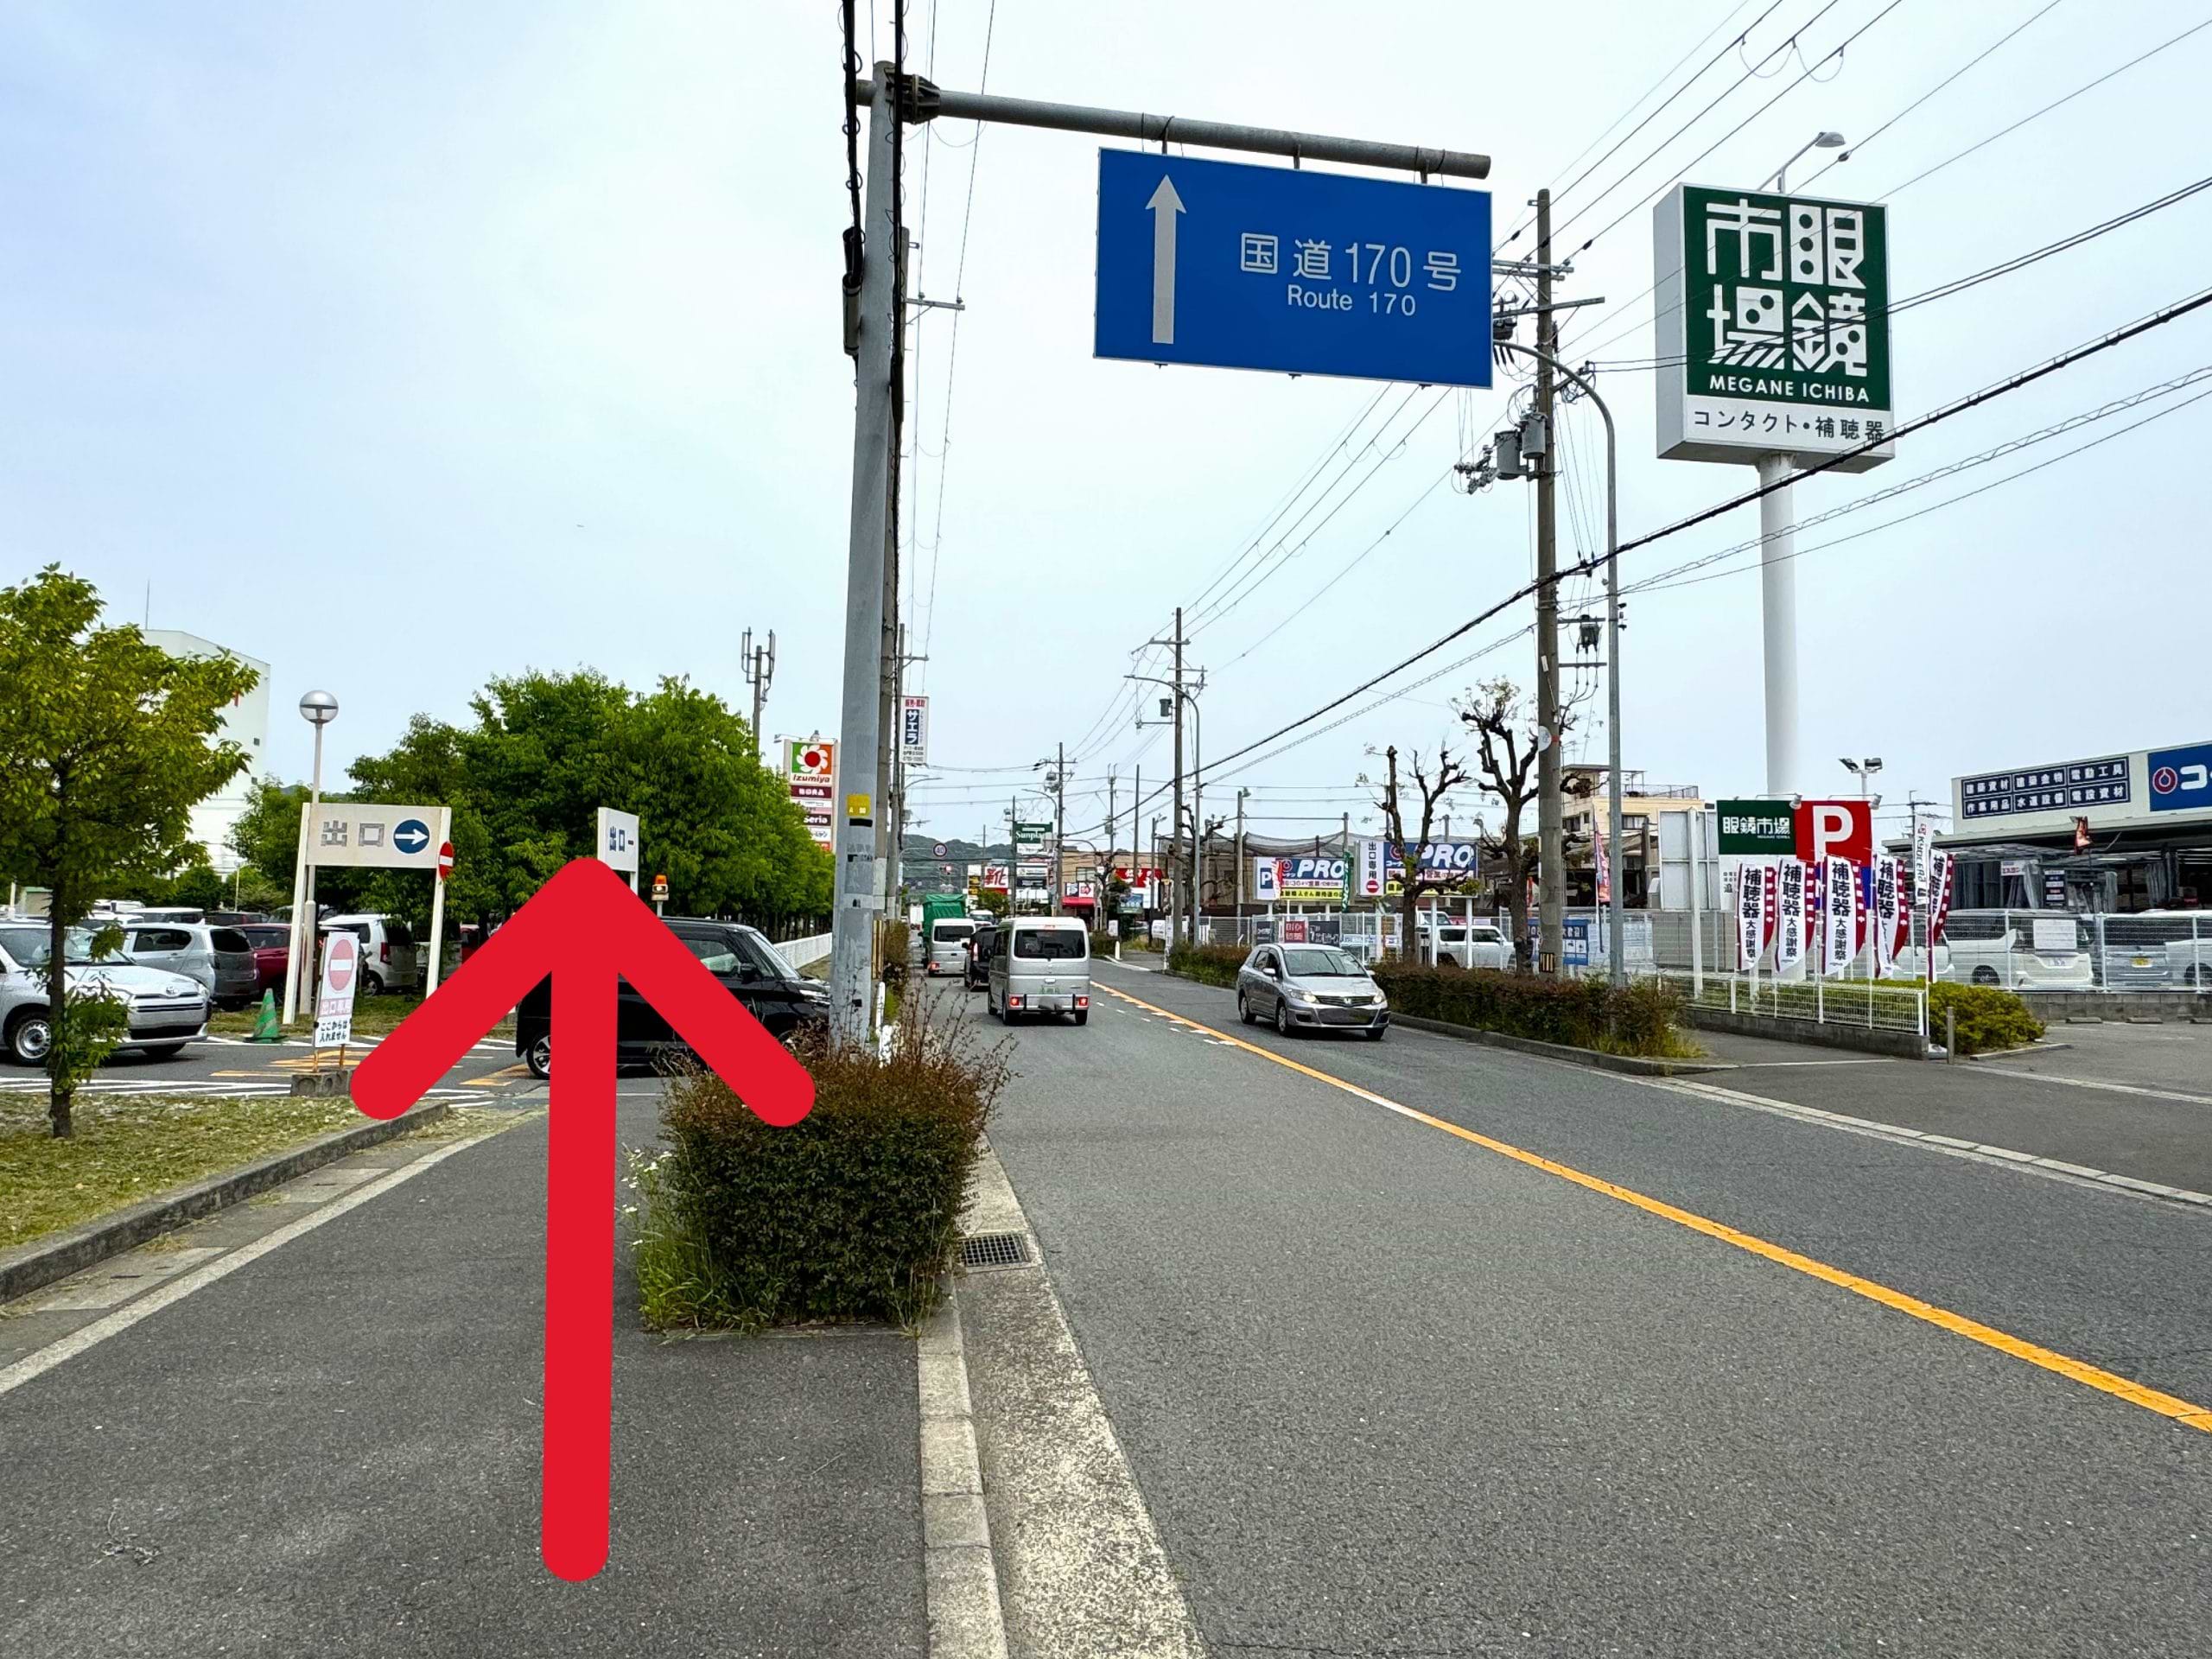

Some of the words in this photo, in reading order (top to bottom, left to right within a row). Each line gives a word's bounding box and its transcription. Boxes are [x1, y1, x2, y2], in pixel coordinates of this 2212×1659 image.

[1240, 232, 1462, 292] 国道170号
[1287, 283, 1353, 312] Route
[1370, 293, 1416, 317] 170
[1709, 374, 1795, 397] MEGANE
[1802, 381, 1870, 403] ICHIBA
[906, 709, 918, 744] サエラ
[2071, 763, 2124, 780] 電動工具
[2179, 764, 2212, 791] コ
[321, 820, 385, 847] 出口
[803, 815, 829, 824] Seria
[1722, 816, 1791, 835] 眼鏡市場
[1813, 805, 1854, 858] P
[609, 825, 626, 852] 出口
[1297, 859, 1345, 879] PRO
[1368, 841, 1377, 880] 出口専用
[1262, 871, 1273, 886] P
[1742, 867, 1763, 918] 補聴器
[1782, 863, 1802, 918] 補聴器
[1831, 861, 1852, 918] 補聴器
[1877, 860, 1896, 919] 補聴器
